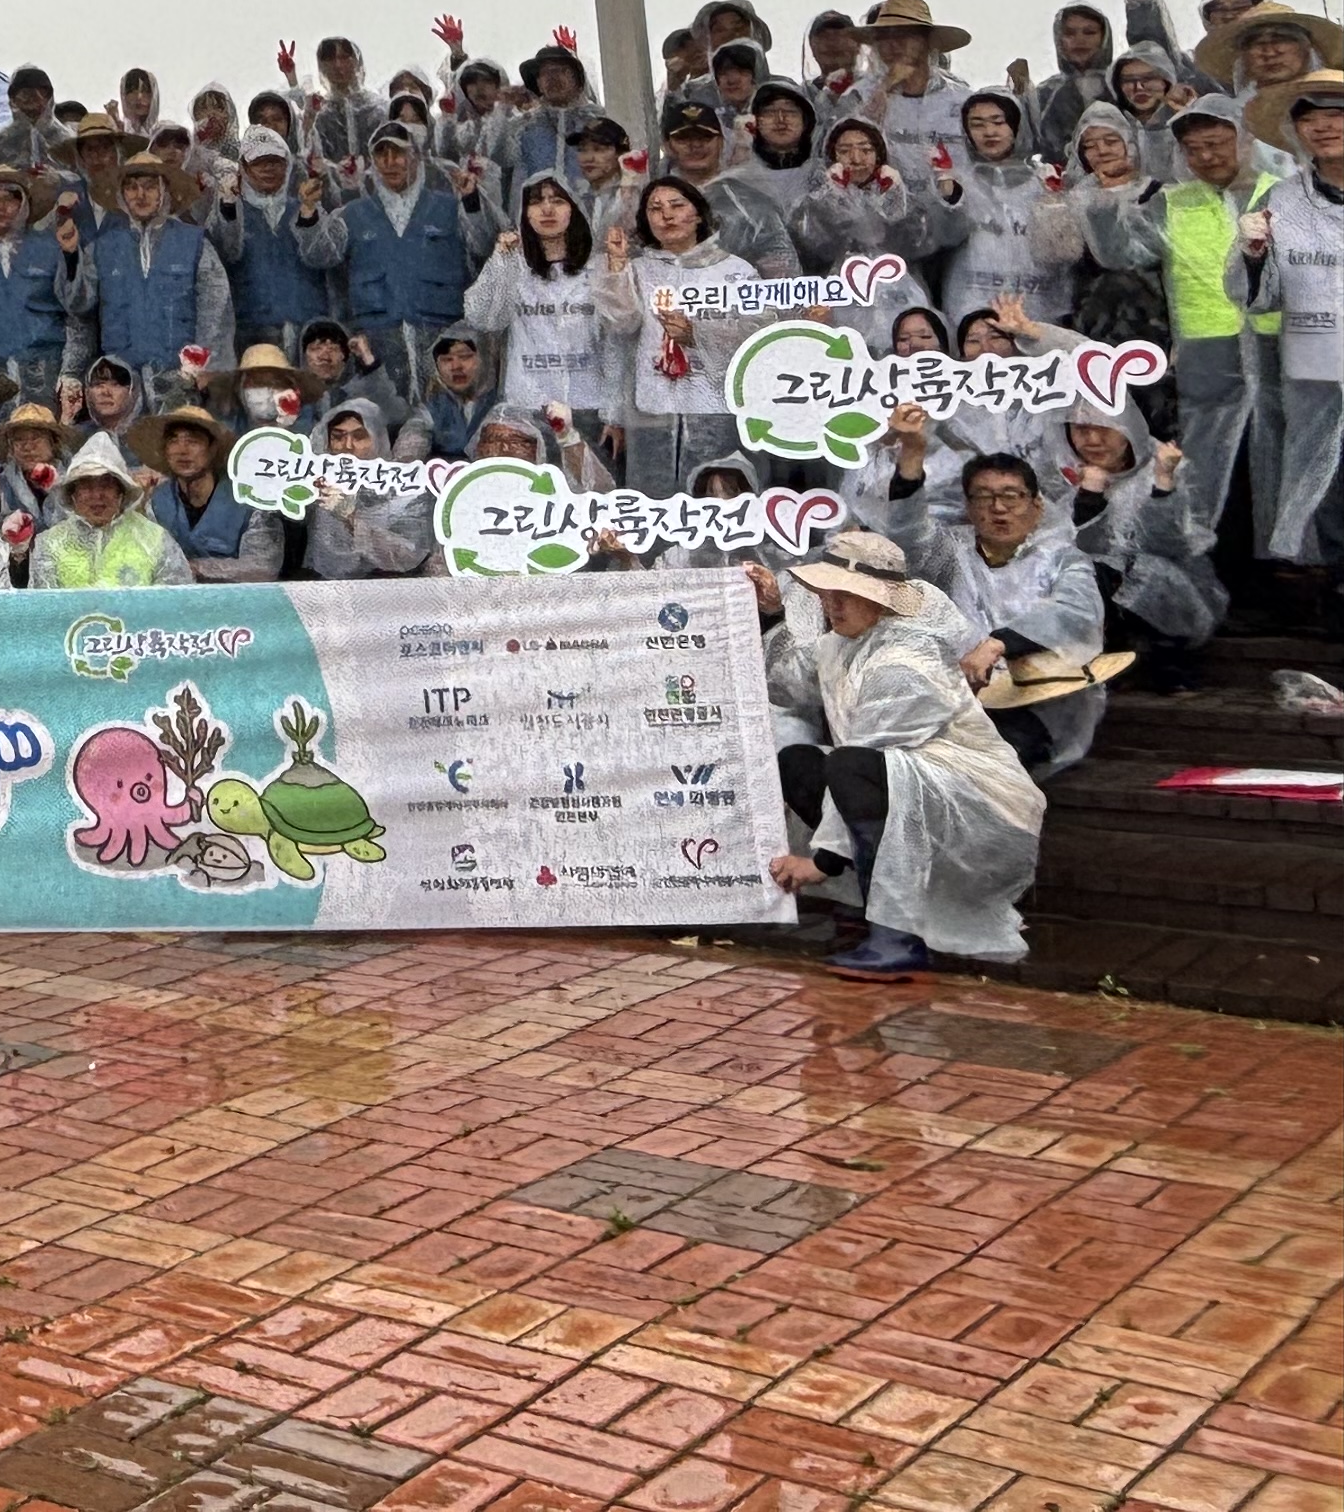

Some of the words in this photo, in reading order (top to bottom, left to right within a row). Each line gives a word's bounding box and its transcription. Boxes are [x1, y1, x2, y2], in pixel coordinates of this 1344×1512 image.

[736, 279, 848, 309] 함께해요
[773, 357, 1066, 416] 그린상륙작전
[254, 457, 421, 493] 그린상륙작전
[479, 493, 757, 548] 그린상륙작전
[422, 687, 472, 713] ITP
